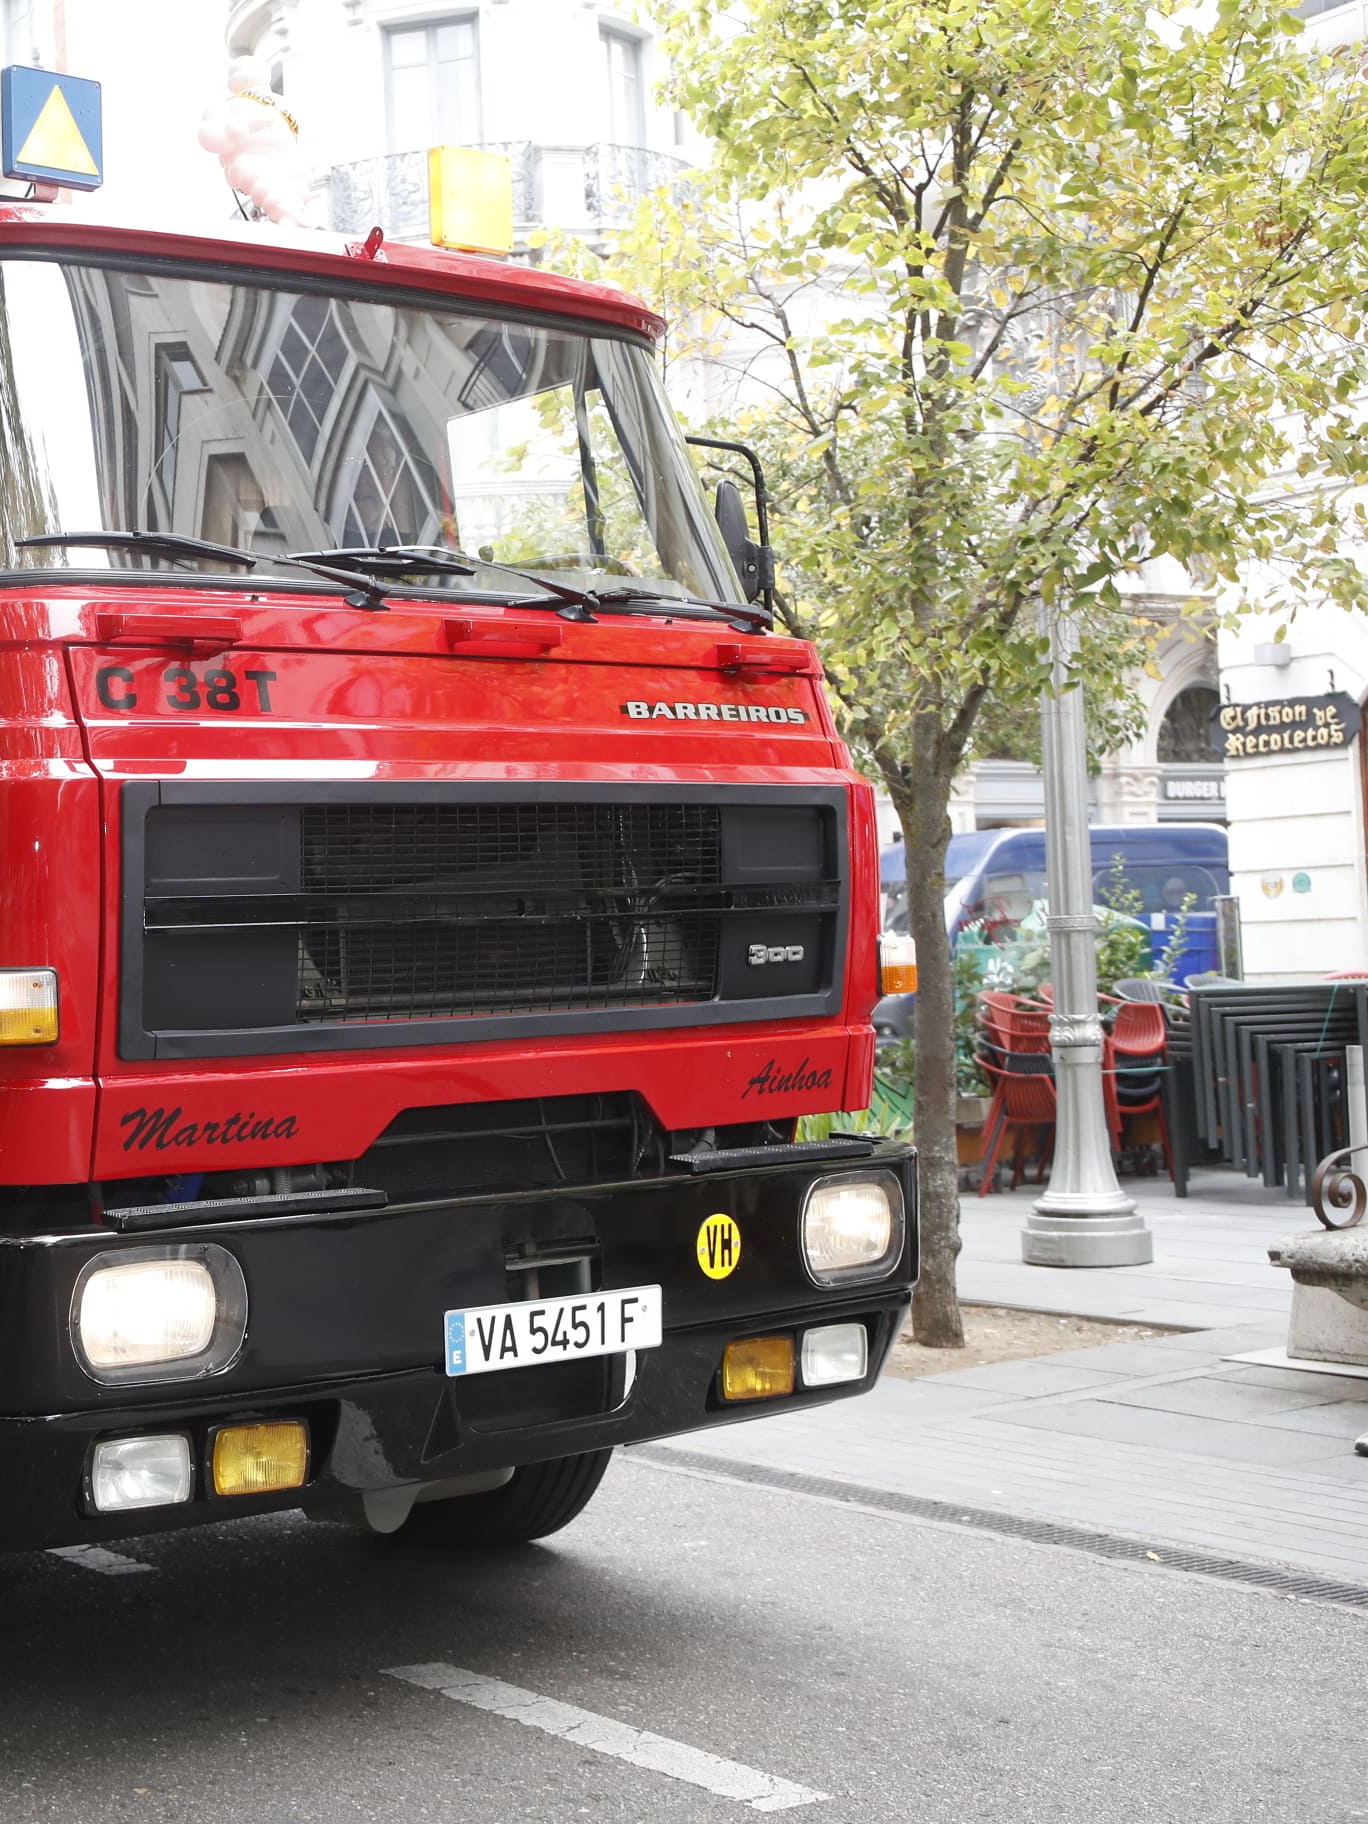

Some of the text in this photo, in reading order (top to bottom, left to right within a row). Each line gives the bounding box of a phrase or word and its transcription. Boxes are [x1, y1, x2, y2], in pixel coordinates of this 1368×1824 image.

[96, 667, 277, 712] C 38T
[626, 701, 805, 724] BARREIROS
[1312, 705, 1339, 726] de
[1224, 722, 1346, 757] Recoletos
[1167, 781, 1218, 797] BURGER
[749, 944, 804, 965] 300
[741, 1058, 832, 1099] Ainhoa
[120, 1107, 299, 1151] Martina
[707, 1223, 732, 1269] VH
[453, 1298, 638, 1364] E VA 5451 F
